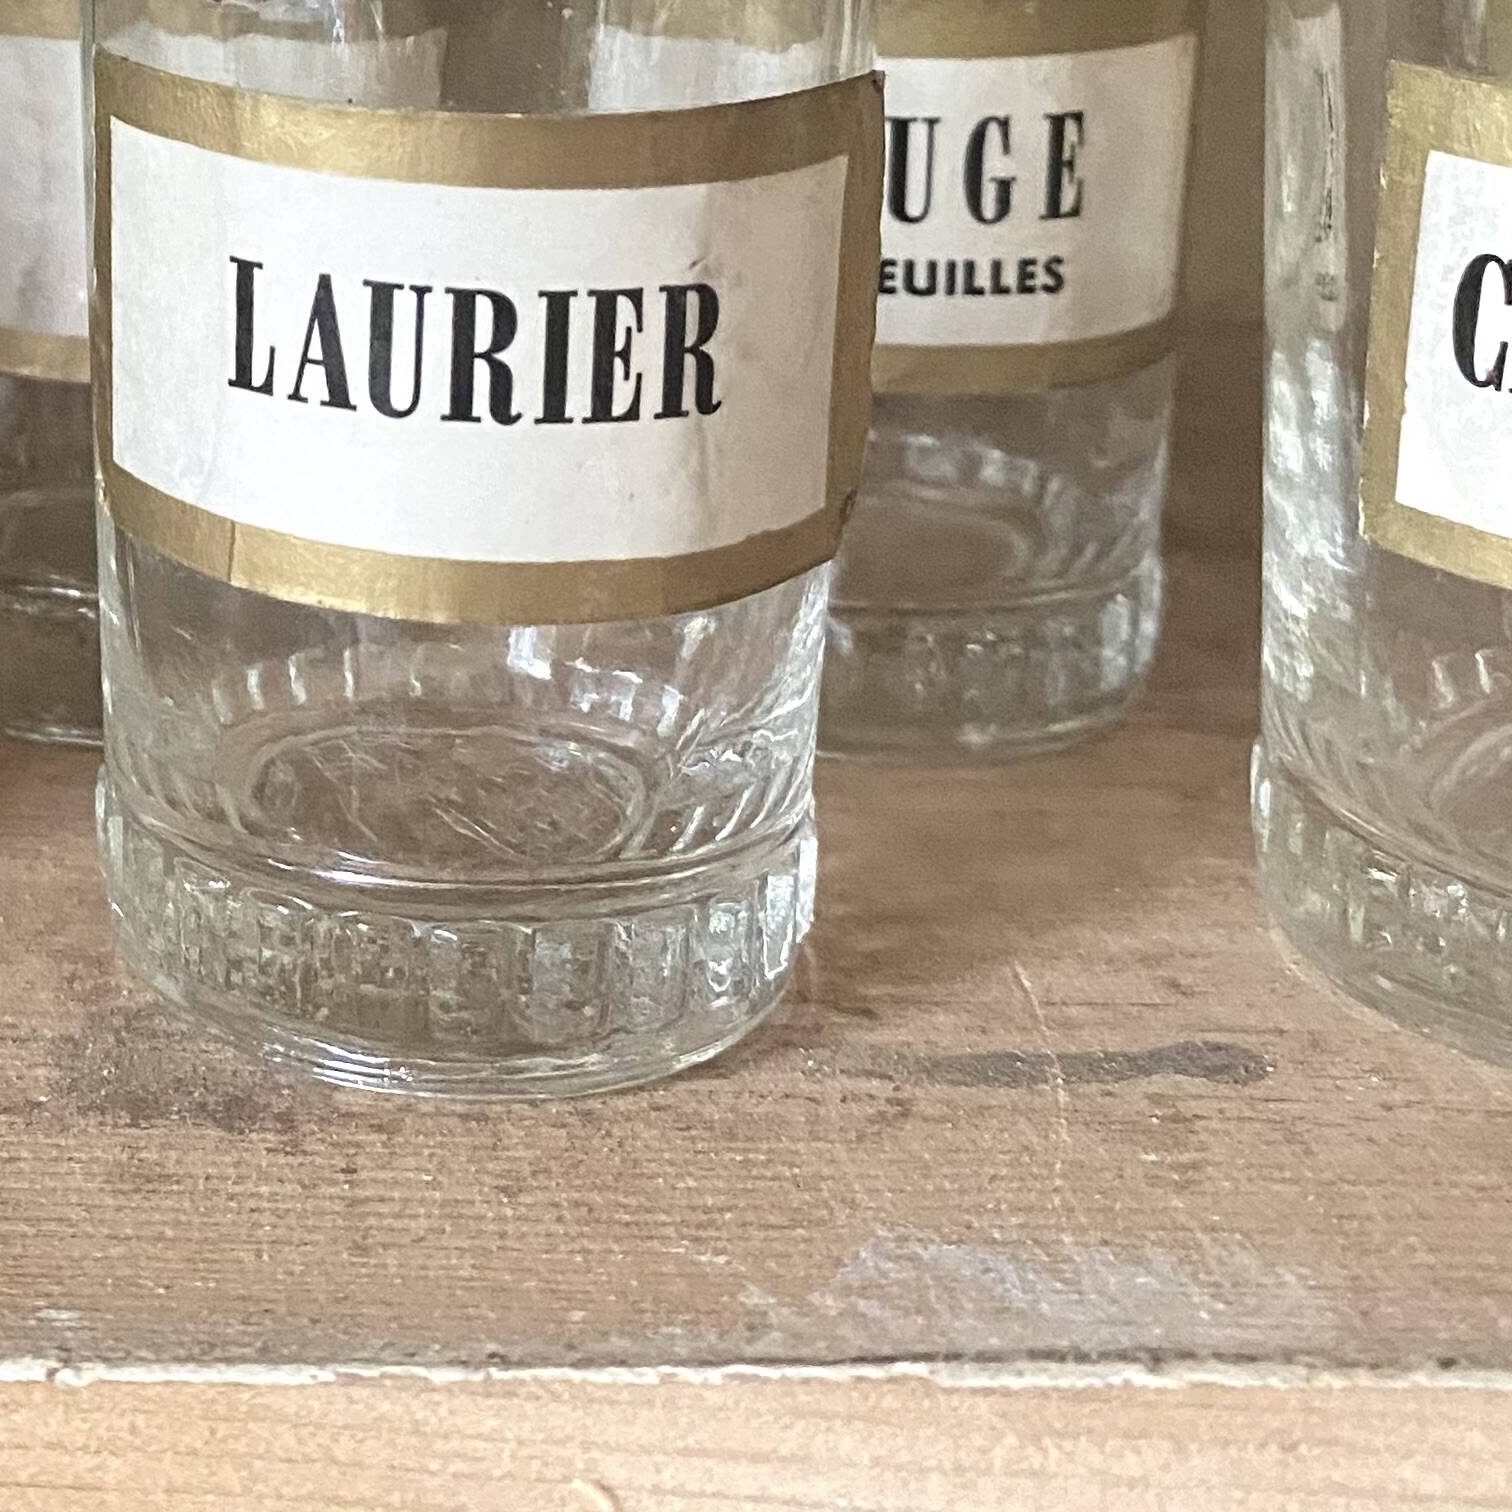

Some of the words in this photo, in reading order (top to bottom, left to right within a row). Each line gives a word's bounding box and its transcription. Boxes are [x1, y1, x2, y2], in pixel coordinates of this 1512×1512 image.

[885, 110, 1086, 225] UGE
[879, 254, 1066, 297] EUILLES
[227, 255, 724, 426] LAURIER
